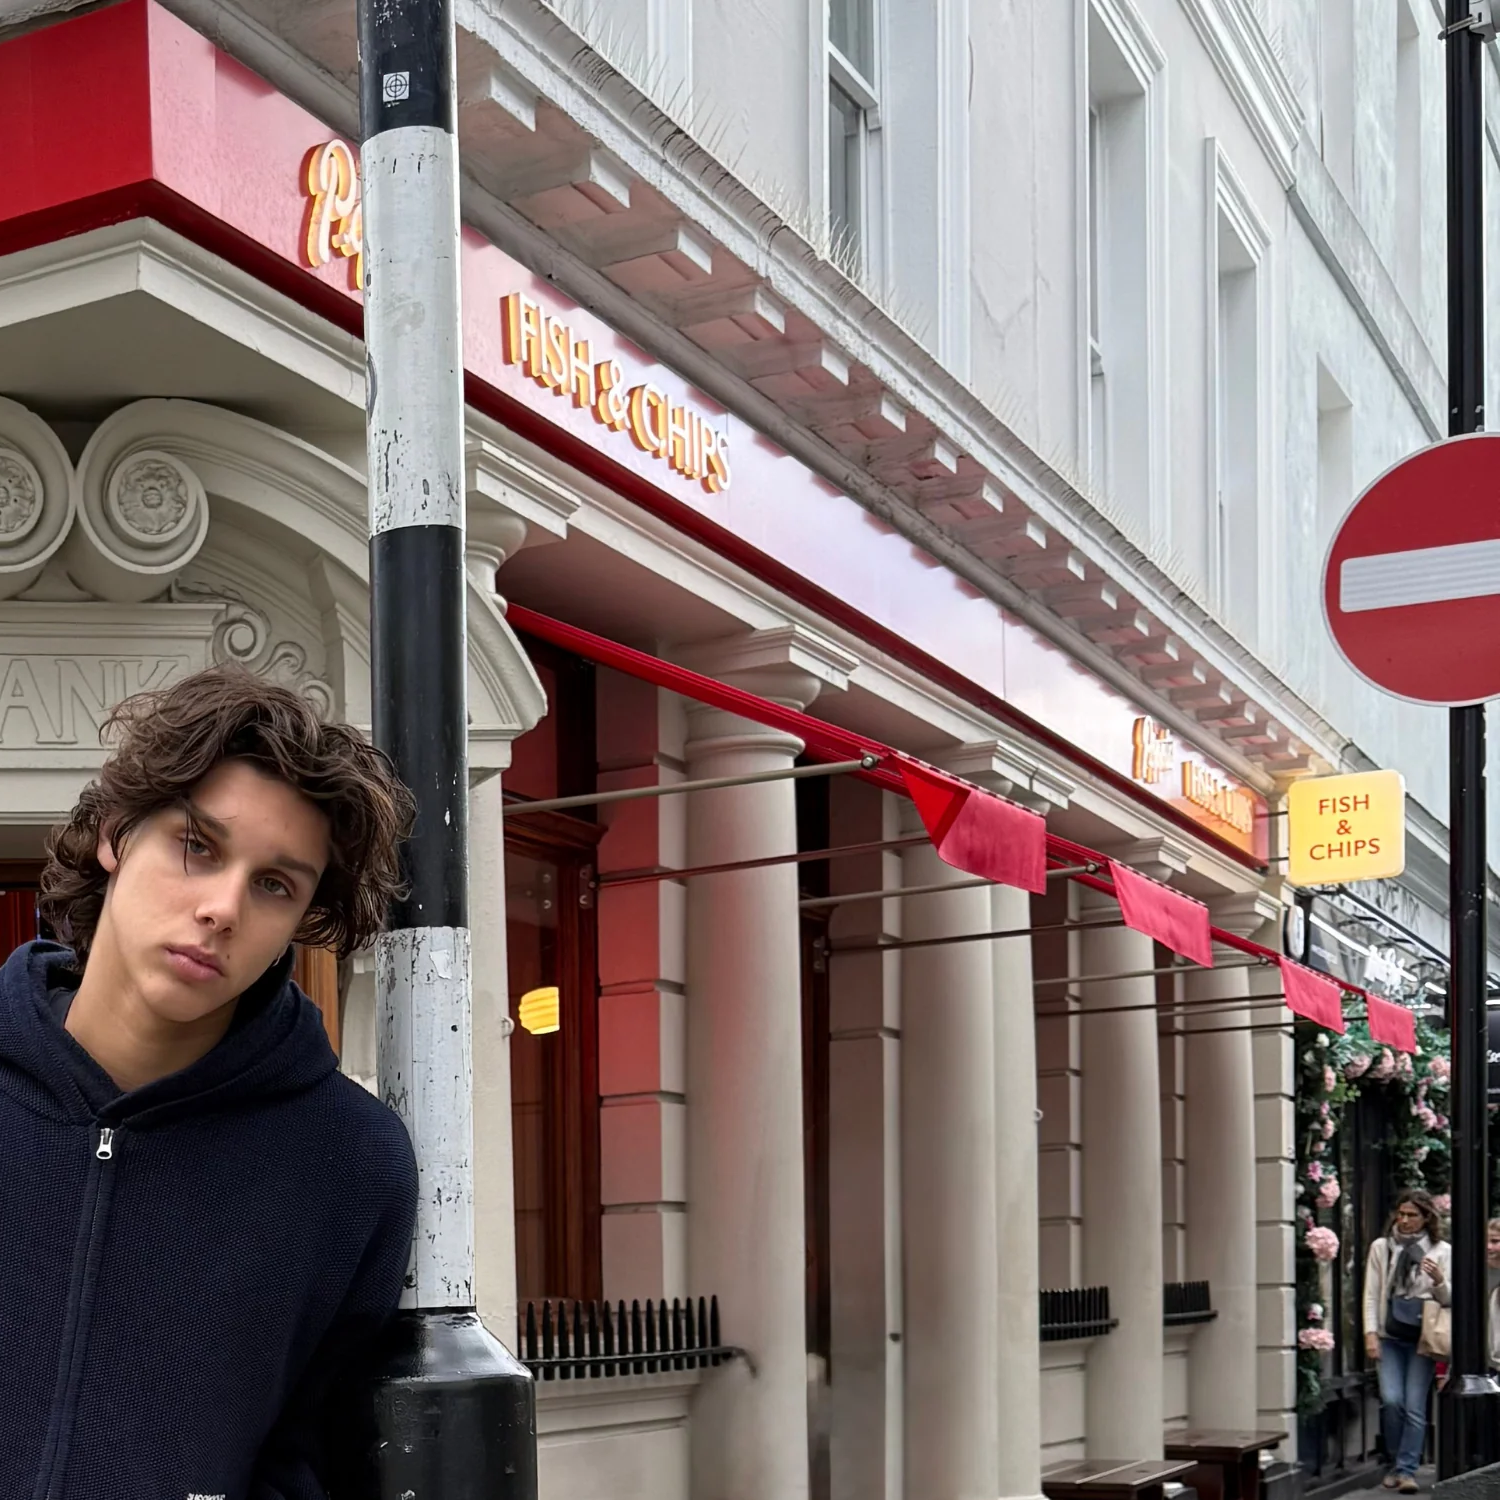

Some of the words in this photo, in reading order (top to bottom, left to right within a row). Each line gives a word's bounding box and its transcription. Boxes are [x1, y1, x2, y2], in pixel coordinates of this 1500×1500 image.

[508, 292, 596, 409] FISH
[598, 357, 631, 431] &
[631, 383, 732, 494] CHIPS
[1319, 794, 1369, 815] FISH
[1336, 819, 1352, 835] &
[1309, 838, 1380, 860] CHIPS
